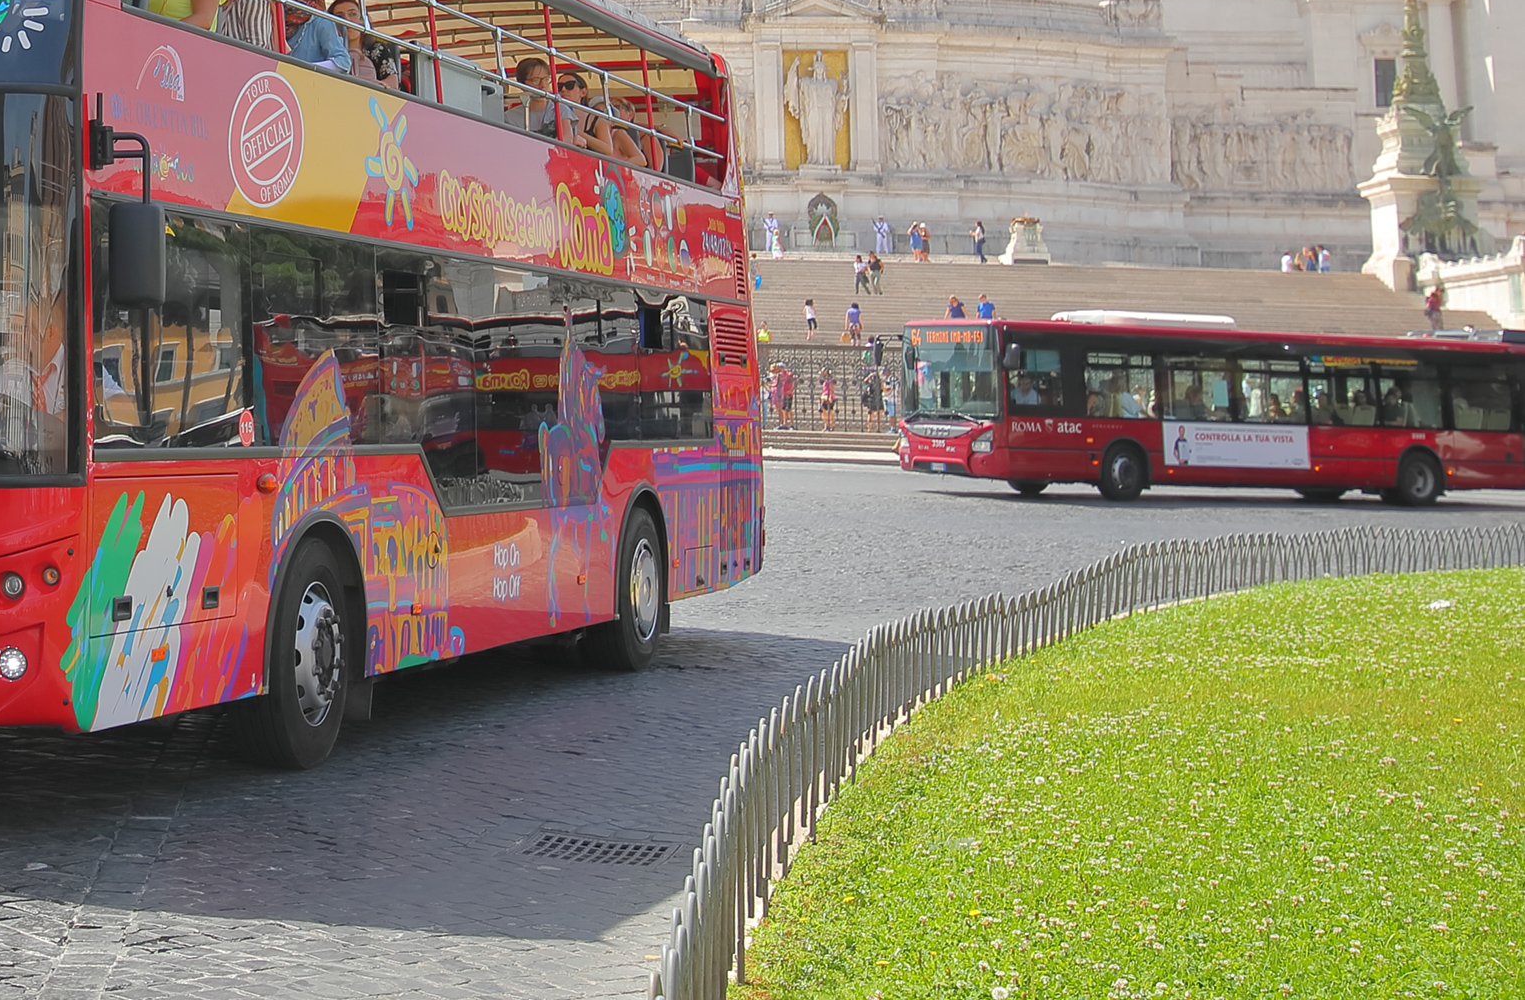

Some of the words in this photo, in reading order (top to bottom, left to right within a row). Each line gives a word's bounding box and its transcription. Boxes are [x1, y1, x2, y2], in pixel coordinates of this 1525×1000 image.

[245, 78, 271, 103] TOUR
[243, 117, 292, 163] OFFICIAL
[260, 186, 272, 203] OF
[272, 166, 295, 199] ROMA
[556, 182, 614, 276] Roma
[910, 328, 922, 346] 64
[926, 330, 949, 343] TERMINI
[241, 421, 253, 434] 115
[1011, 421, 1042, 434] ROMA
[1057, 421, 1082, 434] atac
[1194, 432, 1241, 443] CONTROLLA
[1242, 433, 1253, 443] LA
[1255, 434, 1270, 443] TUA
[1273, 434, 1295, 444] VISTA
[494, 544, 508, 571] Hop
[510, 542, 520, 567] On
[493, 576, 508, 602] Hop
[509, 574, 521, 598] Off
